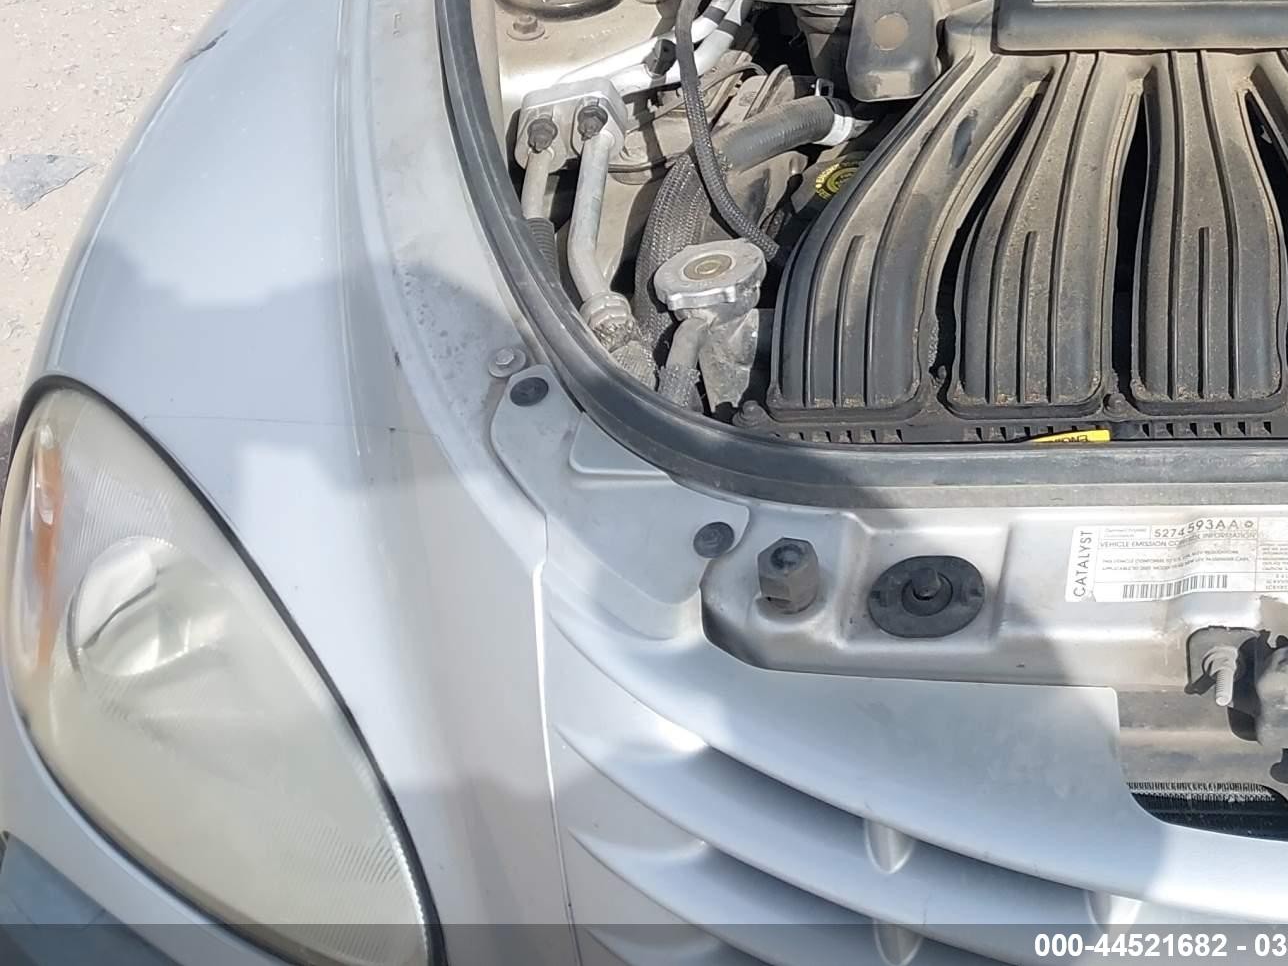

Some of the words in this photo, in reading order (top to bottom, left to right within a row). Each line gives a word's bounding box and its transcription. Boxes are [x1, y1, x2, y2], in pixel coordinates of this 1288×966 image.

[1100, 540, 1130, 548] VEHICLE
[1131, 538, 1167, 547] EMISSION
[1202, 530, 1256, 539] INFORMATION
[1153, 519, 1240, 539] 5274593AA
[1073, 530, 1093, 598] CATALYST
